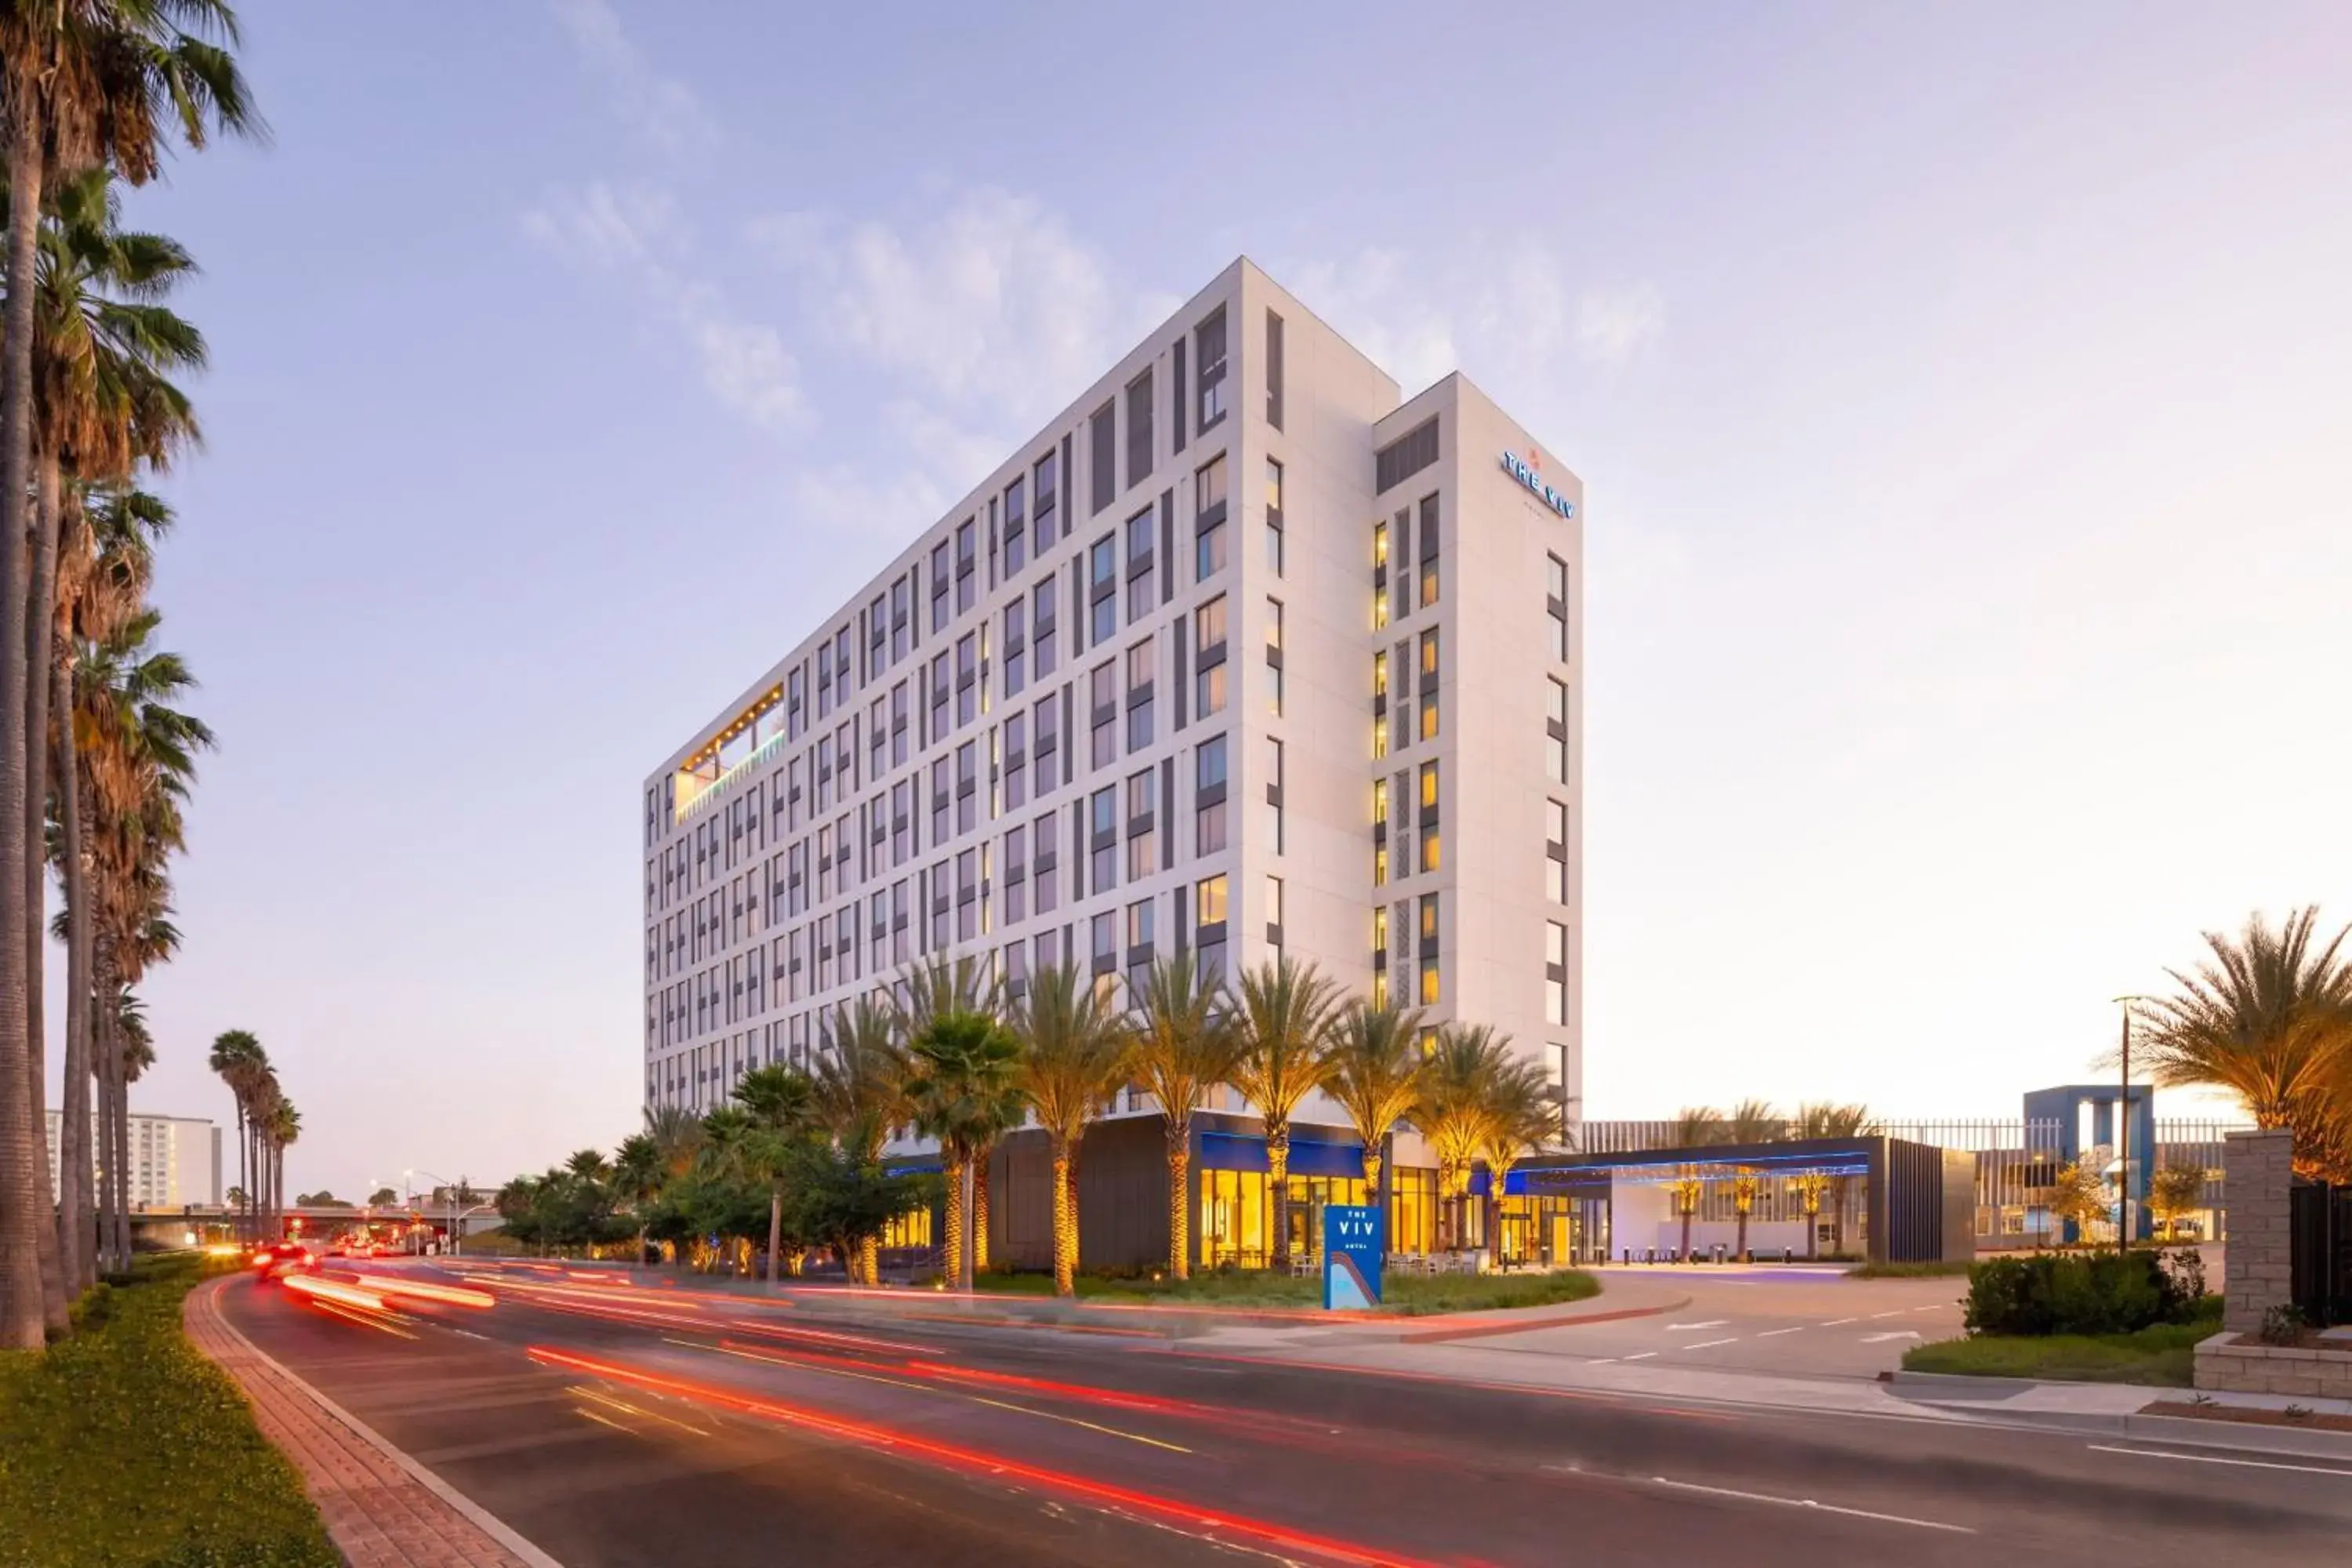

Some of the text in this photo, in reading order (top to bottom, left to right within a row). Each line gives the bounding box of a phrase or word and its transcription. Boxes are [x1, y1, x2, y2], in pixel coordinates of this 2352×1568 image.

[1504, 451, 1540, 492] THE
[1545, 485, 1574, 519] VIV
[1339, 1221, 1374, 1236] VIV
